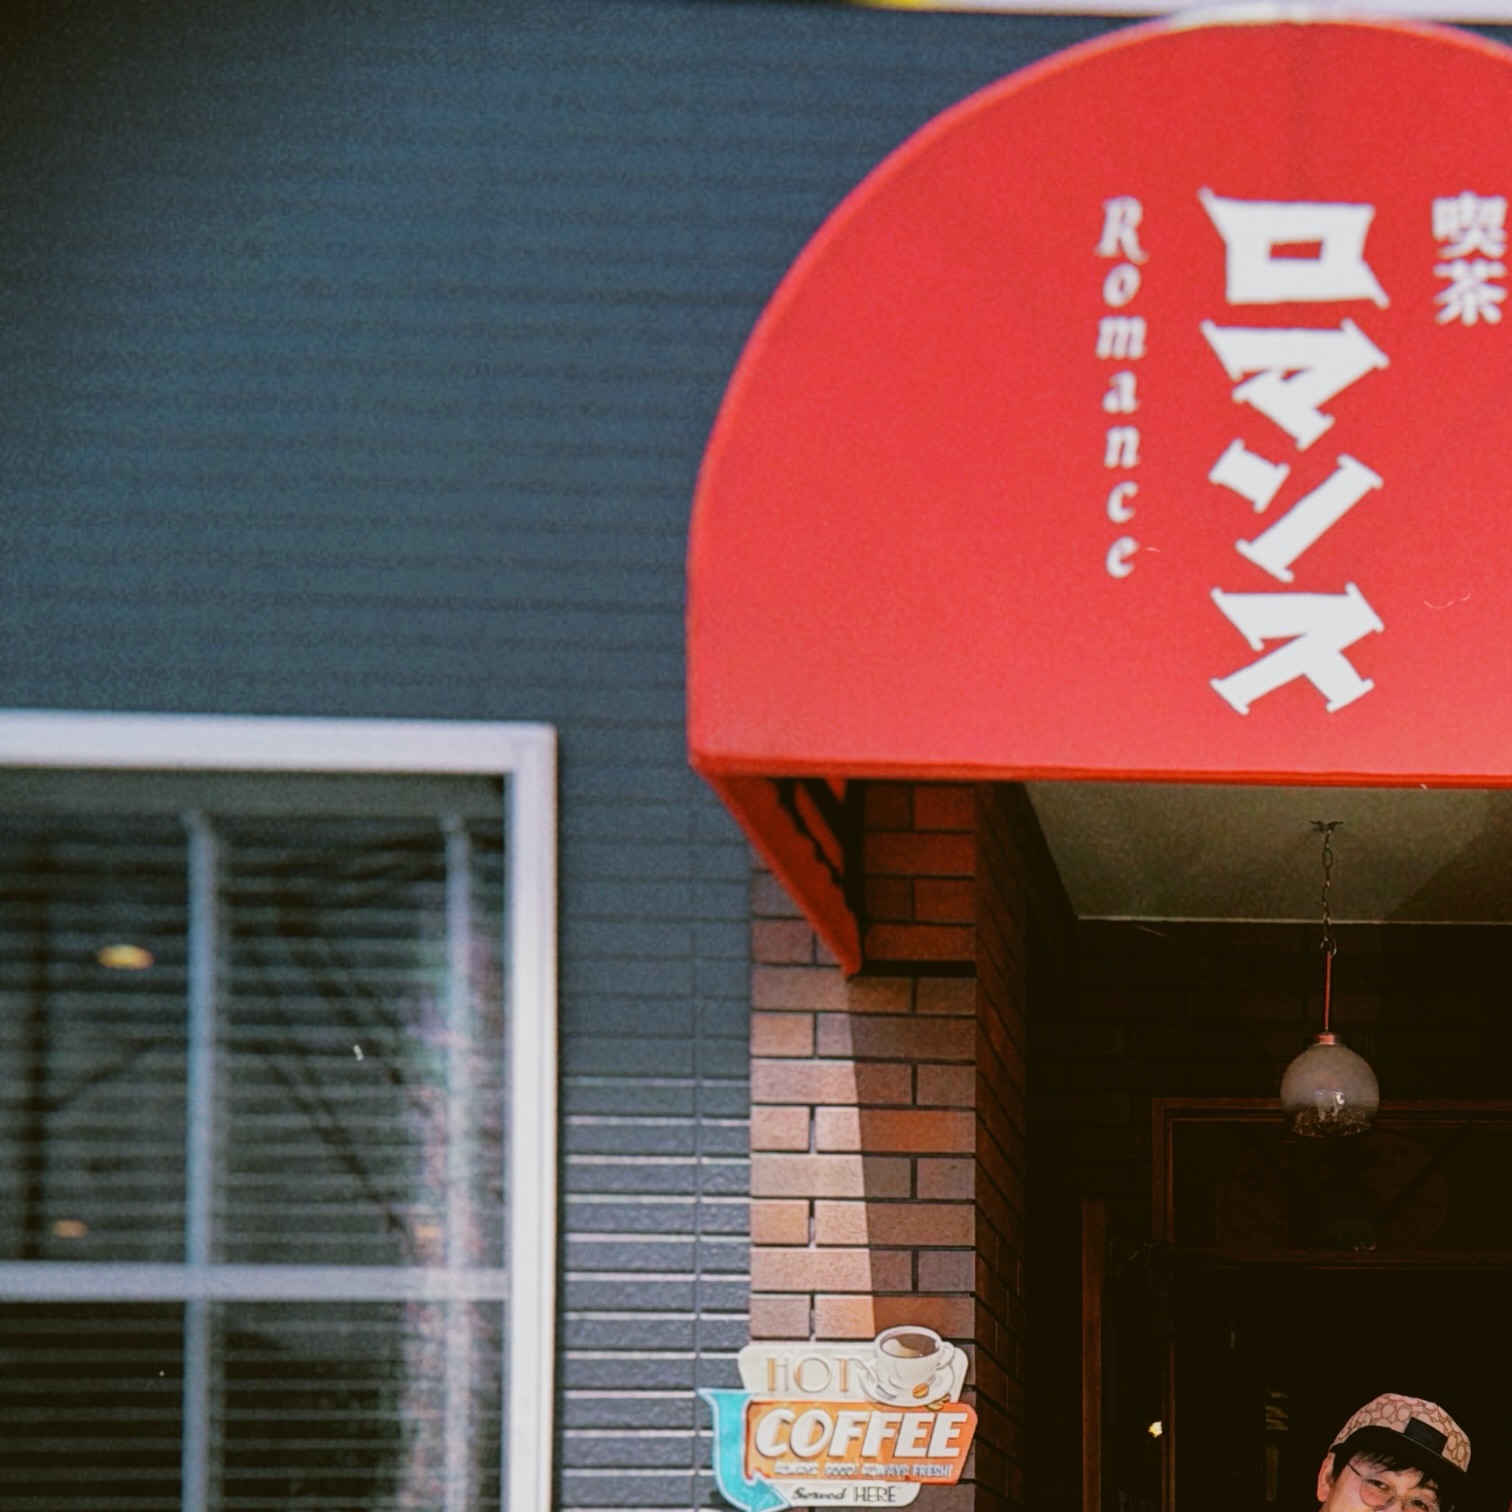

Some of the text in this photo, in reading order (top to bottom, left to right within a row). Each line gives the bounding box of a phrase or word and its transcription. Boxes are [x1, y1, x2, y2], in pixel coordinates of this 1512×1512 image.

[1432, 191, 1508, 326] 喫茶
[1096, 195, 1148, 578] Romance
[1199, 187, 1389, 716] ロマンス
[766, 1353, 863, 1393] HOT
[755, 1408, 968, 1458] COFFEE
[853, 1486, 897, 1502] HERE
